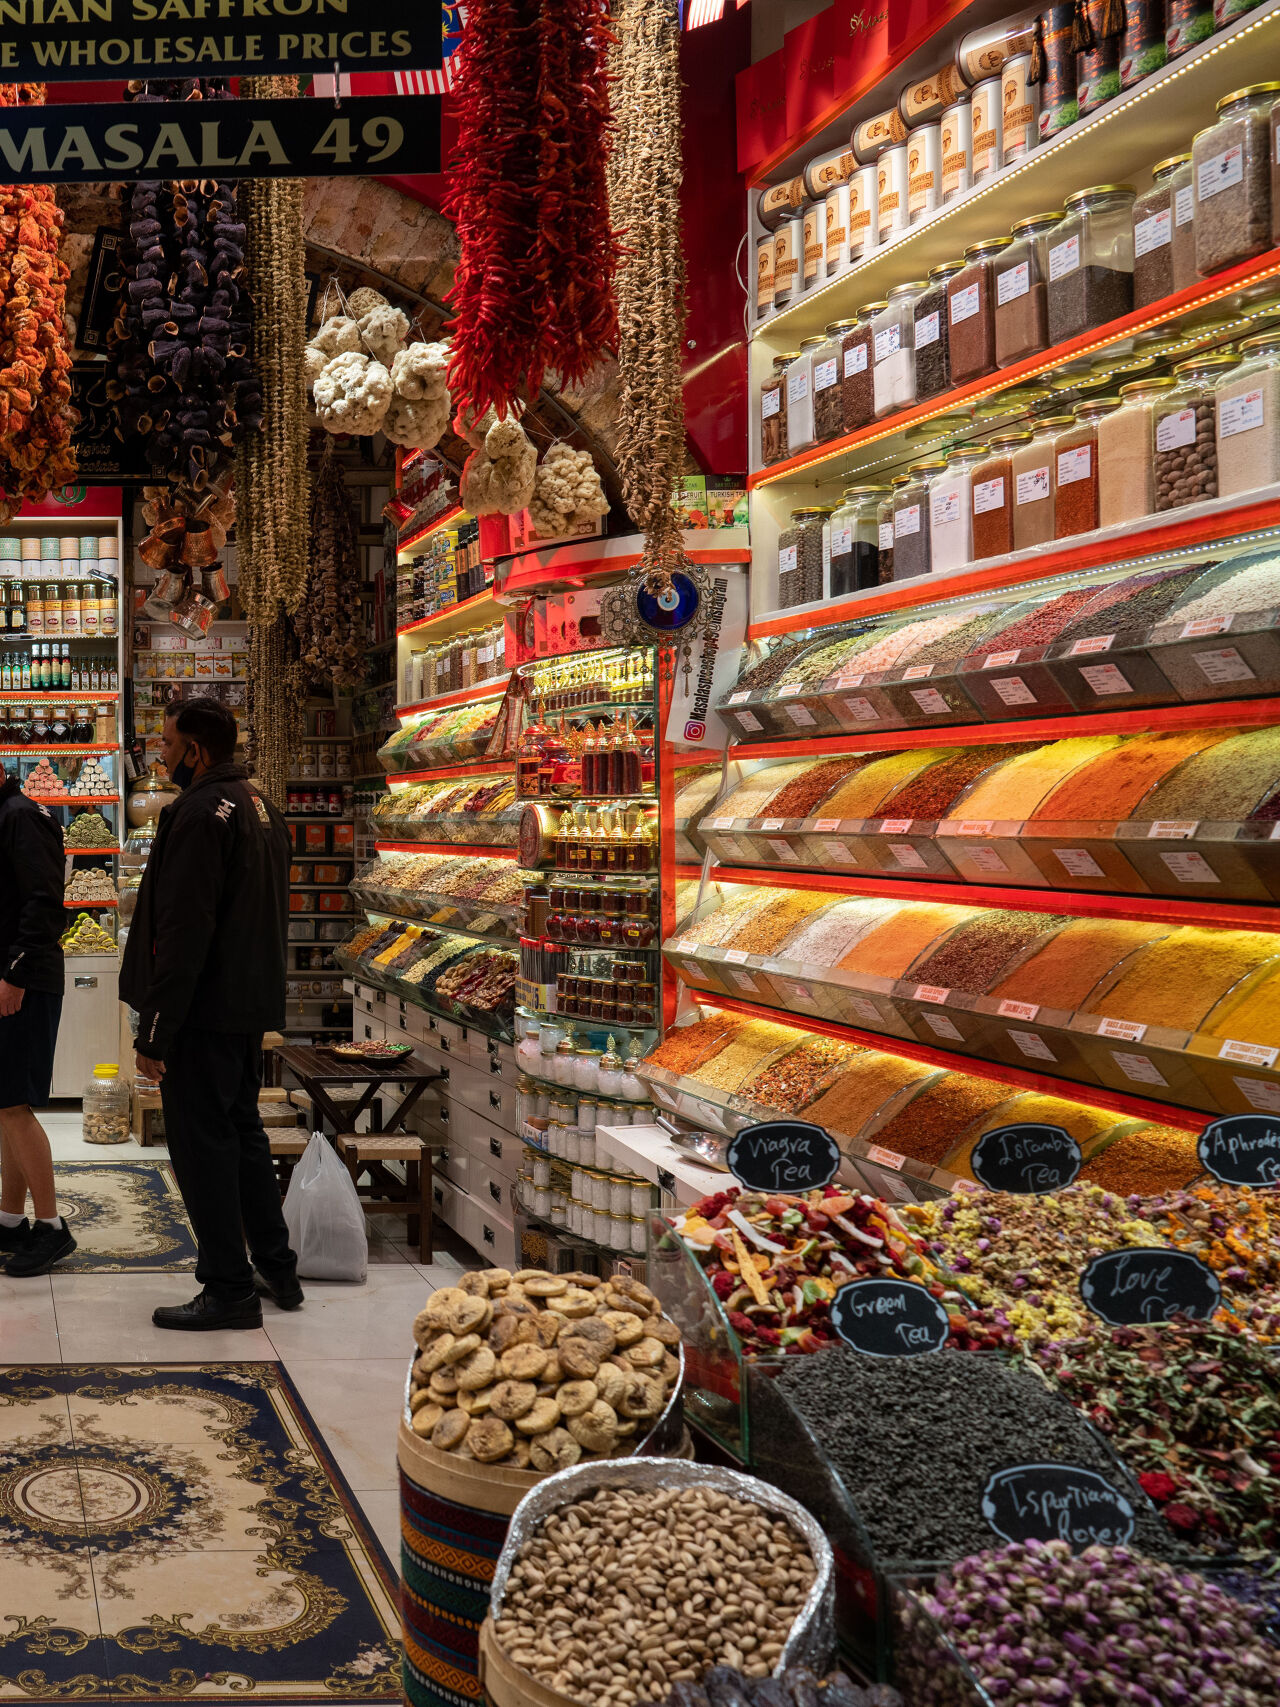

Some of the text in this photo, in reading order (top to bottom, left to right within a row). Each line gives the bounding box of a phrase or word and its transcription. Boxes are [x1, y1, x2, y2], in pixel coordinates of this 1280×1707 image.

[131, 0, 350, 21] SAFFRON
[32, 34, 264, 67] WHOLESALE
[278, 30, 412, 60] PRICES
[311, 116, 405, 164] 49
[771, 1158, 813, 1190] Tea
[1021, 1163, 1062, 1192] Tea
[1256, 1158, 1280, 1182] Te
[894, 1322, 936, 1348] Tea
